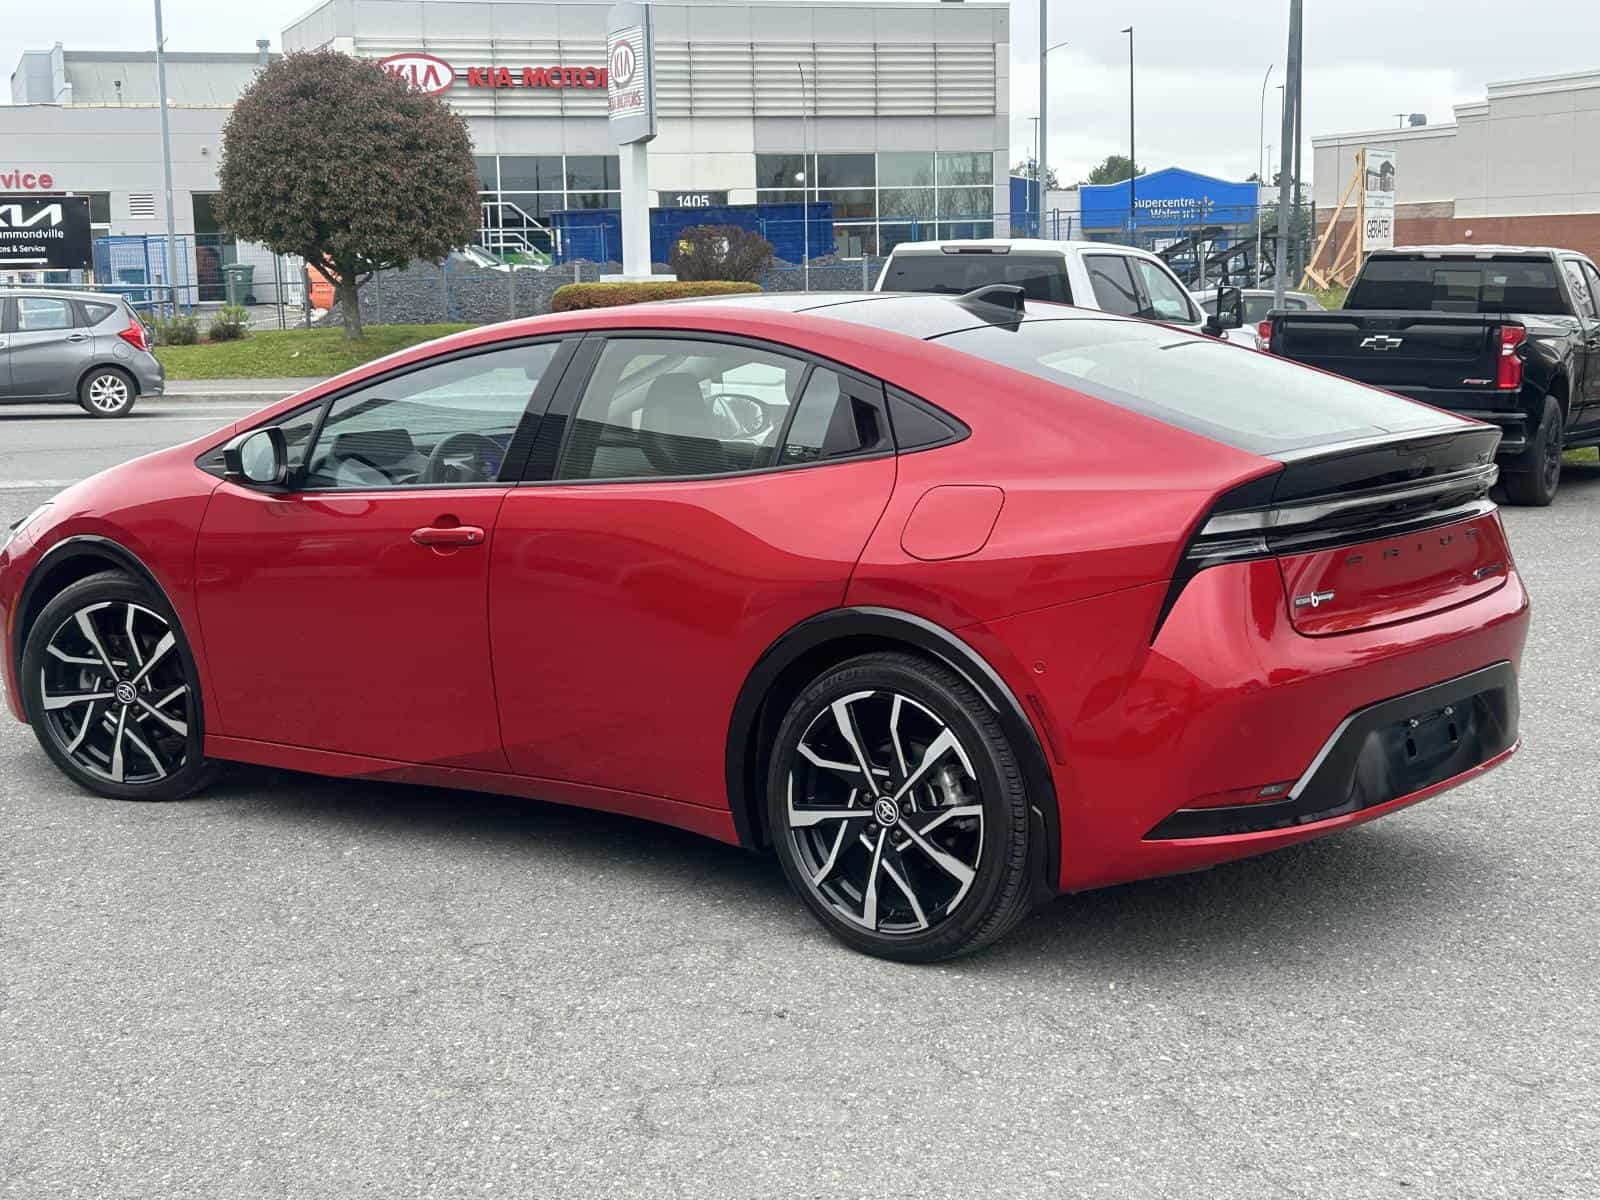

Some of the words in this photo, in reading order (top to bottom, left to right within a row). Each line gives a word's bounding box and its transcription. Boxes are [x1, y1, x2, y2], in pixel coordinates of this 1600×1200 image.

[613, 49, 632, 79] KIA
[467, 66, 513, 88] KIA
[0, 169, 53, 189] vice
[676, 194, 710, 208] 1405
[19, 245, 46, 253] Service
